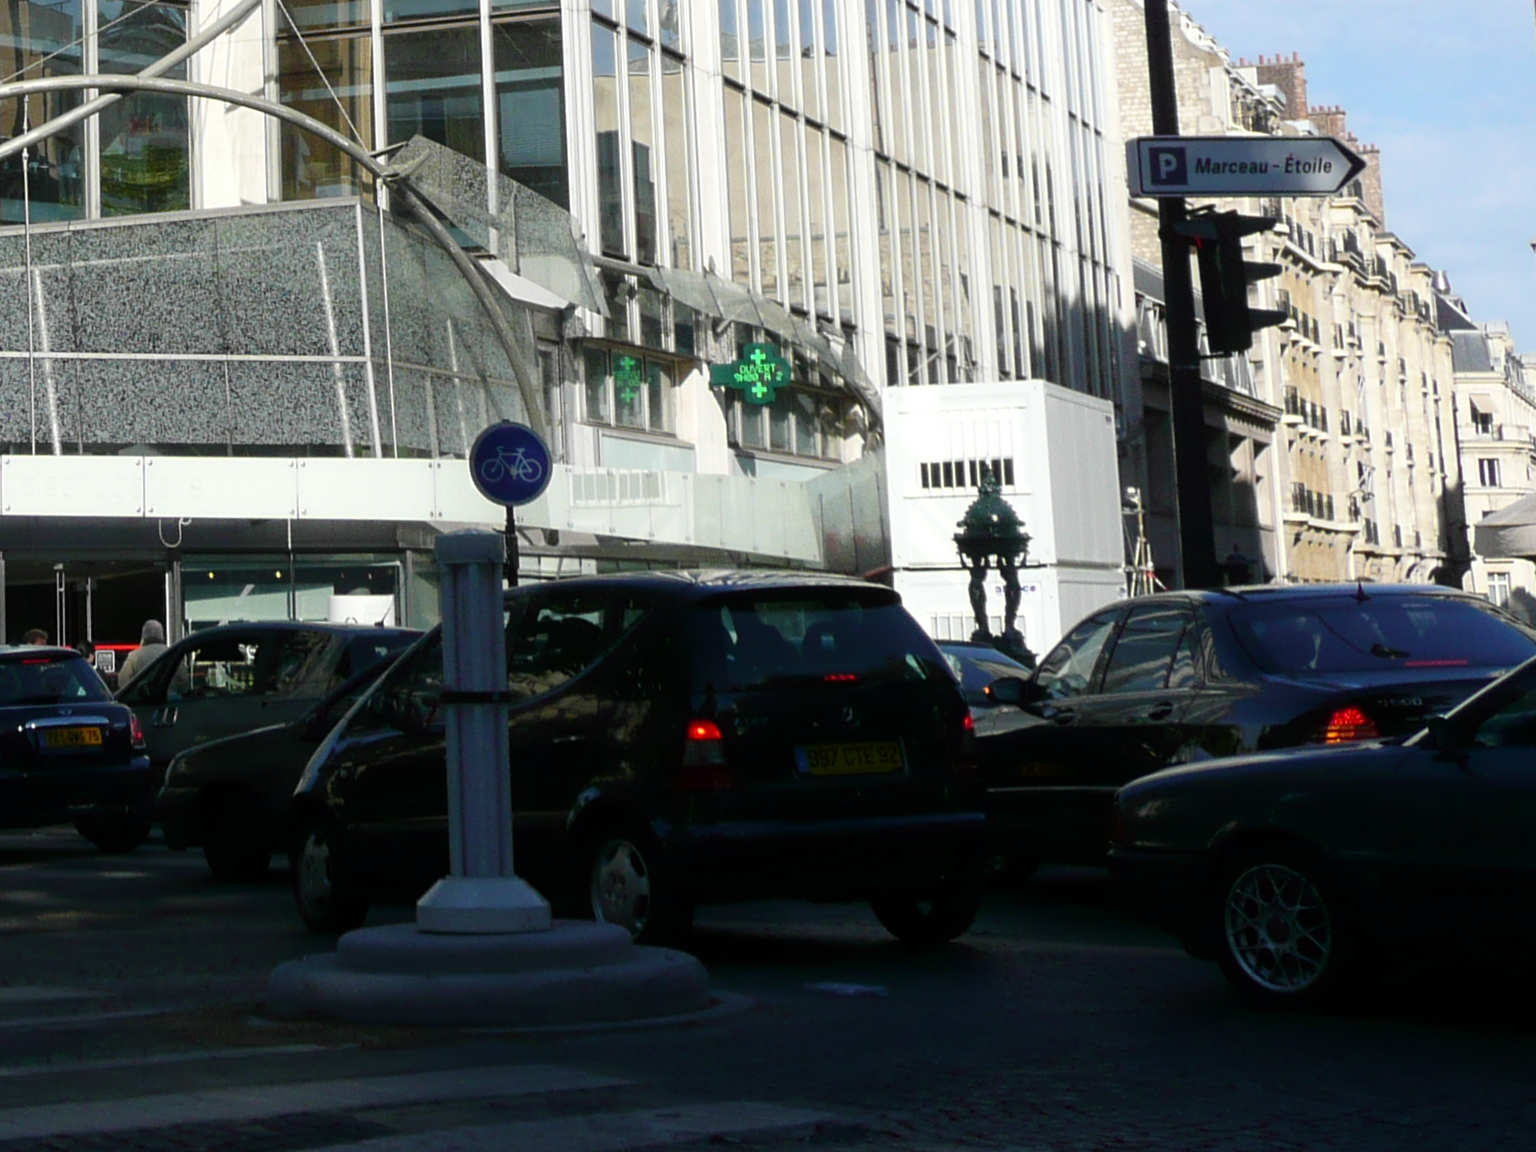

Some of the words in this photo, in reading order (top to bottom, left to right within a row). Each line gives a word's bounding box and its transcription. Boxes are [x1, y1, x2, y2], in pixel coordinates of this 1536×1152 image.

[1158, 152, 1178, 180] P
[1194, 157, 1269, 175] Marceau
[1284, 153, 1333, 175] Étoile
[739, 363, 776, 374] OUVERT
[86, 729, 100, 742] 75
[843, 746, 874, 766] CTE
[876, 745, 898, 764] 92
